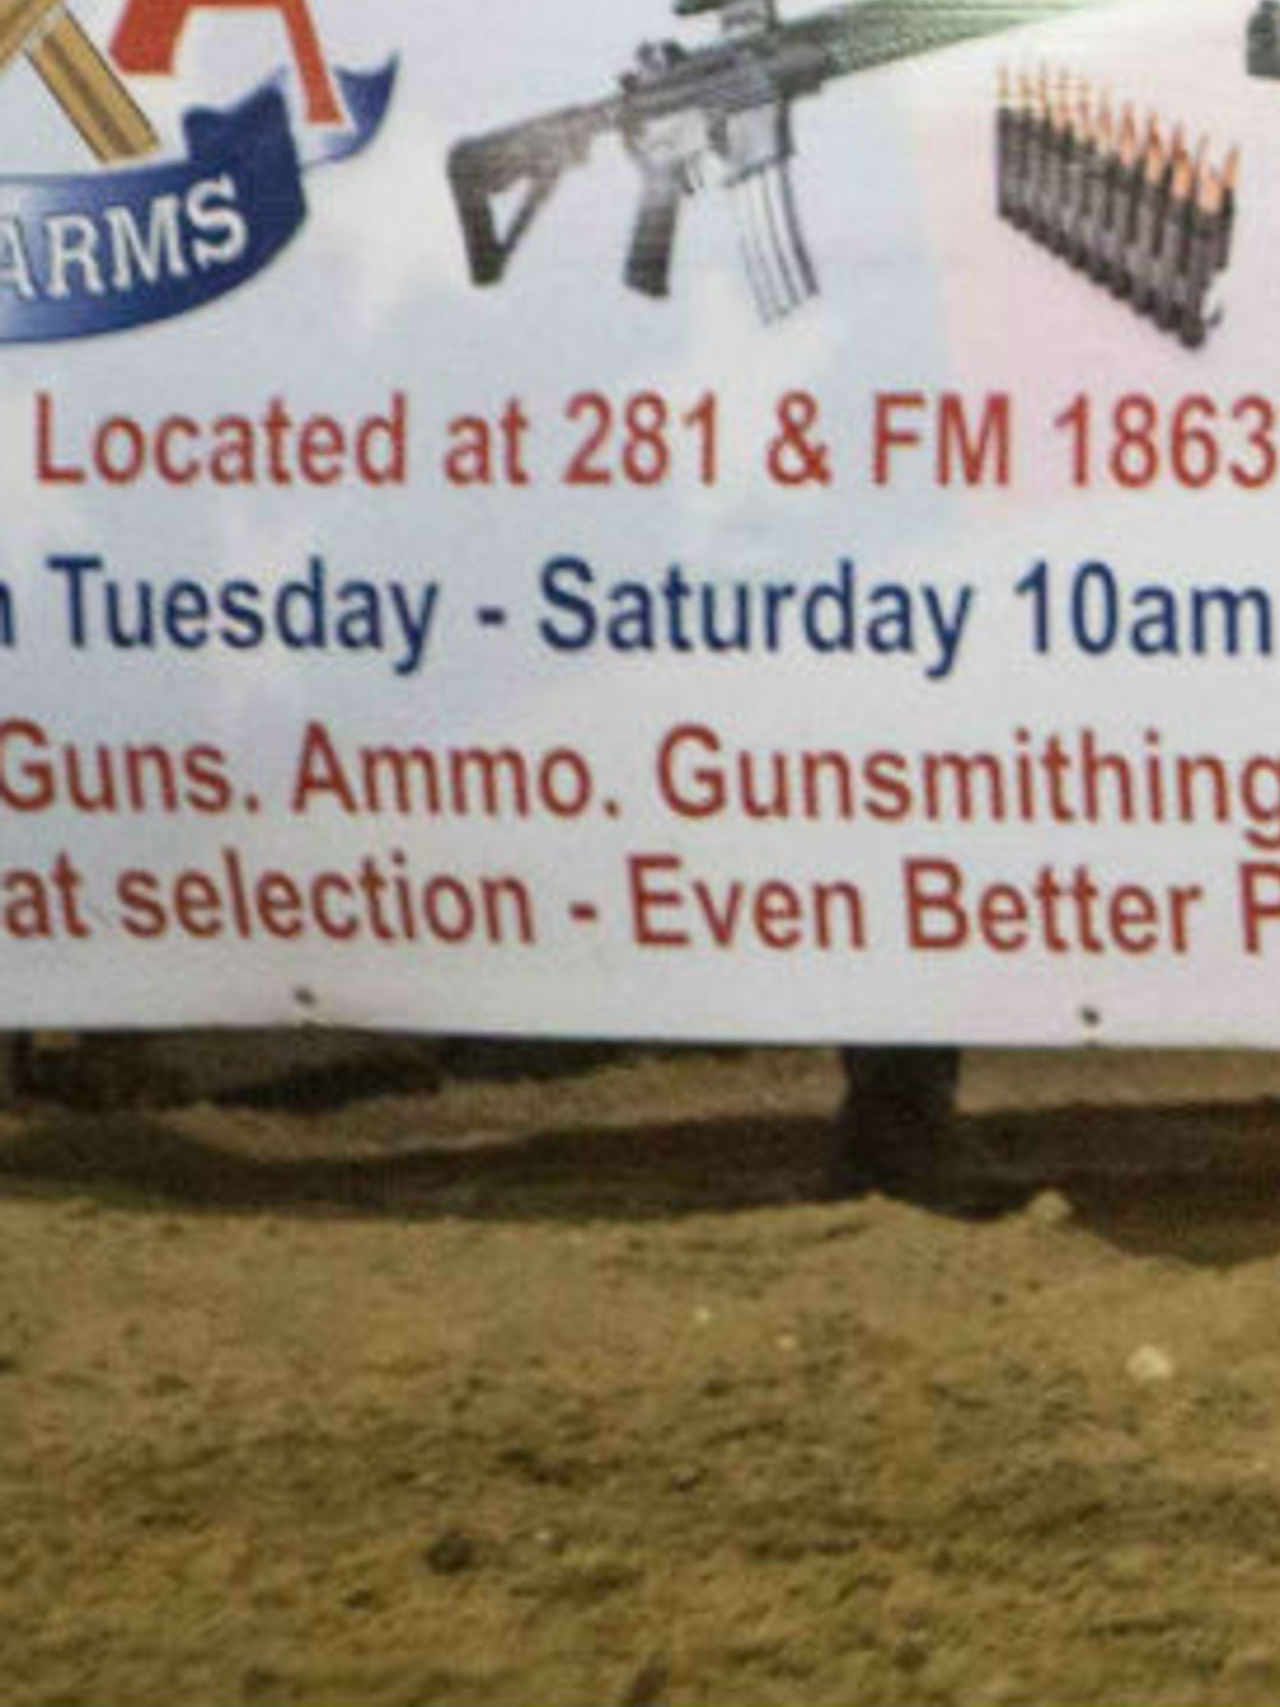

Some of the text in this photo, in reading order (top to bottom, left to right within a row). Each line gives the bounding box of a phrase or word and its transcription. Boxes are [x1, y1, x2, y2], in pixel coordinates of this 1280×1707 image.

[34, 390, 1280, 491] Located at 281 & FM 1863
[44, 554, 440, 675] Tuesday
[538, 555, 975, 679] Saturday
[1014, 559, 1274, 657] 10am
[0, 718, 260, 815] Guns.
[291, 722, 621, 820] Ammo.
[117, 849, 535, 945] selection
[627, 854, 867, 952] Even
[904, 858, 1205, 959] Better
